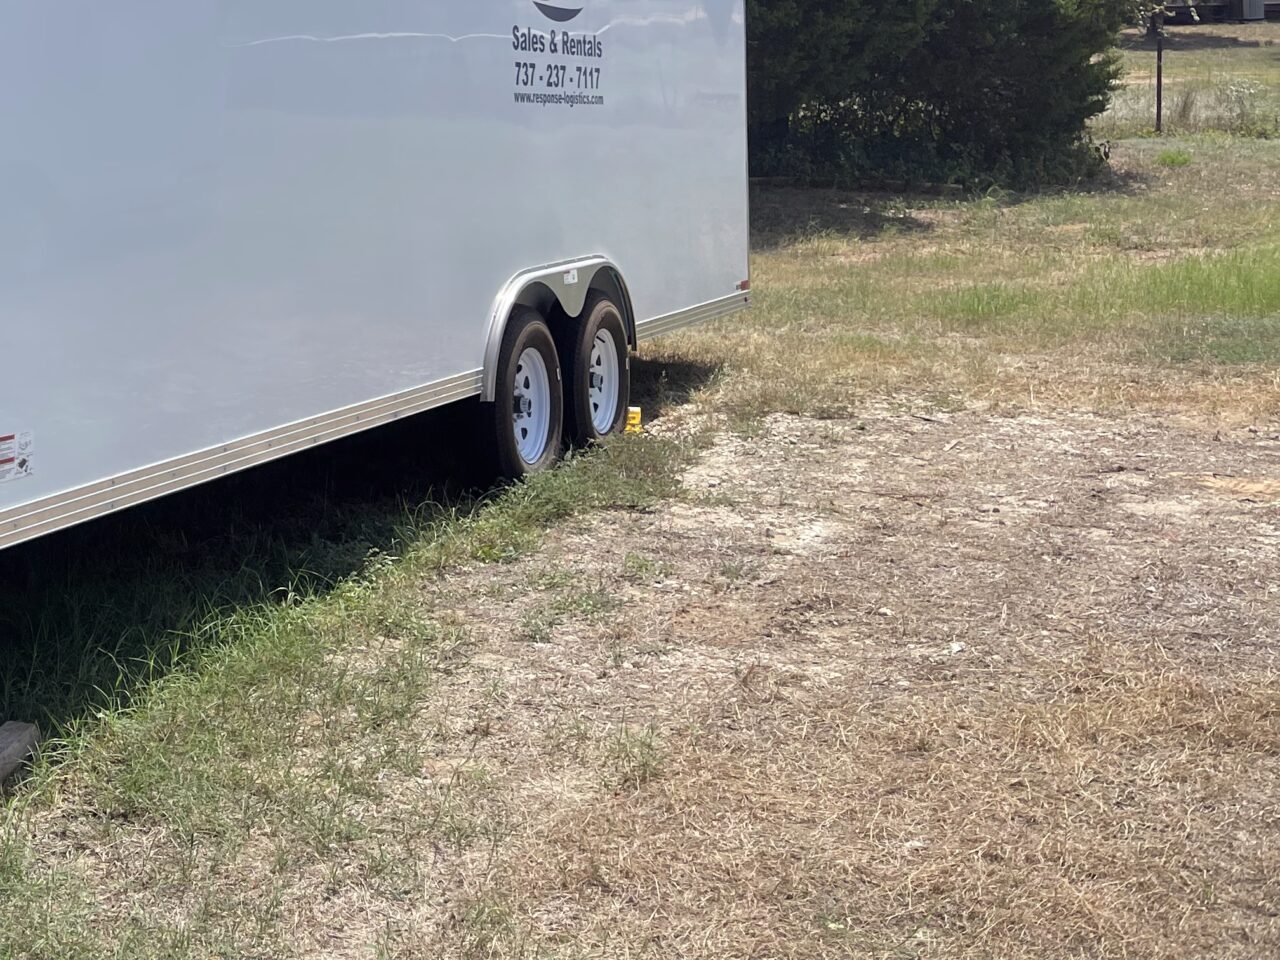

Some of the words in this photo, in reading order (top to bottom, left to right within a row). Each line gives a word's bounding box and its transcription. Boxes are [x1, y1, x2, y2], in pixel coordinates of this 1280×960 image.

[512, 25, 546, 53] Sales
[549, 29, 558, 54] &
[562, 31, 603, 58] Rentals
[515, 61, 536, 87] 737
[546, 63, 567, 88] 237
[576, 66, 601, 89] 7117
[513, 91, 604, 108] www.response-logistics.com
